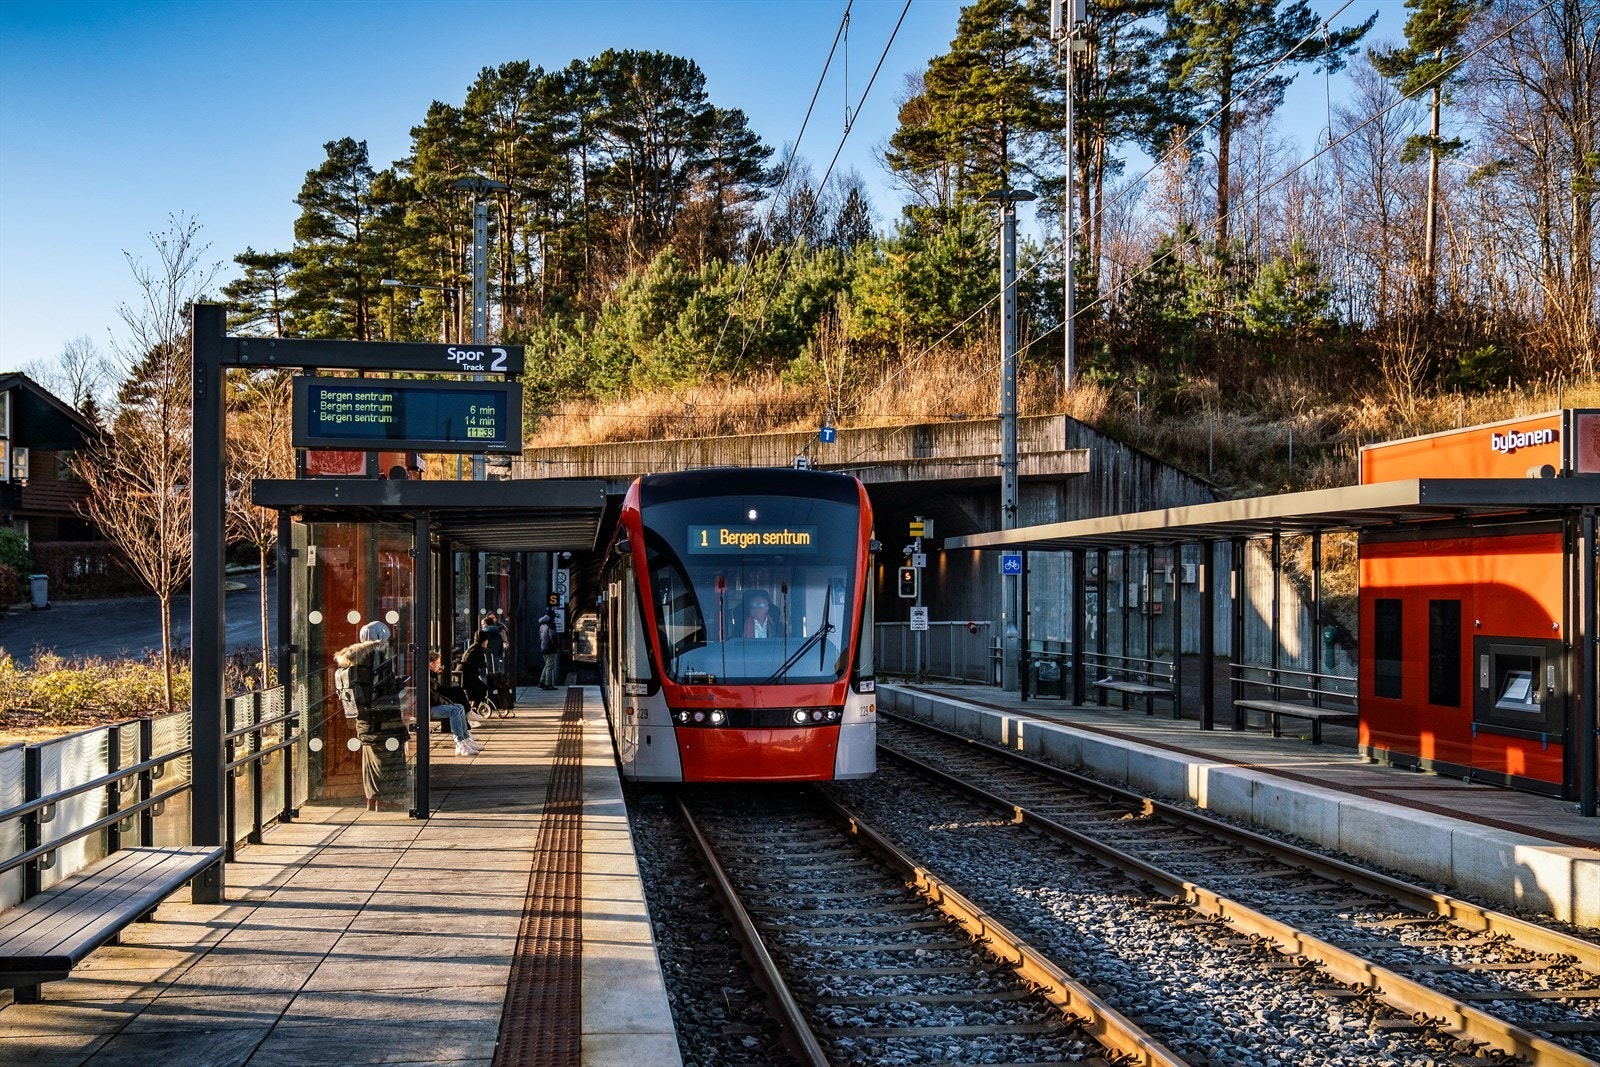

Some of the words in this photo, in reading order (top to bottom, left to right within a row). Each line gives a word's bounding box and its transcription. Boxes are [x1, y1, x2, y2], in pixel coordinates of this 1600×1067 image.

[447, 347, 485, 363] Spor
[490, 348, 508, 372] 2
[462, 363, 485, 371] Track
[320, 390, 353, 402] Bergen
[355, 392, 393, 402] sentrum
[320, 401, 353, 413] Bergen
[354, 403, 393, 412] sentrum
[469, 405, 476, 415] 6
[479, 405, 495, 415] min
[320, 411, 352, 424] Bergen
[354, 413, 393, 423] sentrum
[464, 416, 476, 425] 14
[479, 416, 495, 426] min
[468, 428, 495, 438] 11:33
[823, 429, 833, 441] T
[1491, 428, 1553, 455] bybanen
[701, 530, 709, 547] 1
[720, 529, 761, 549] Bergen
[762, 529, 811, 545] sentrum
[549, 595, 558, 605] S
